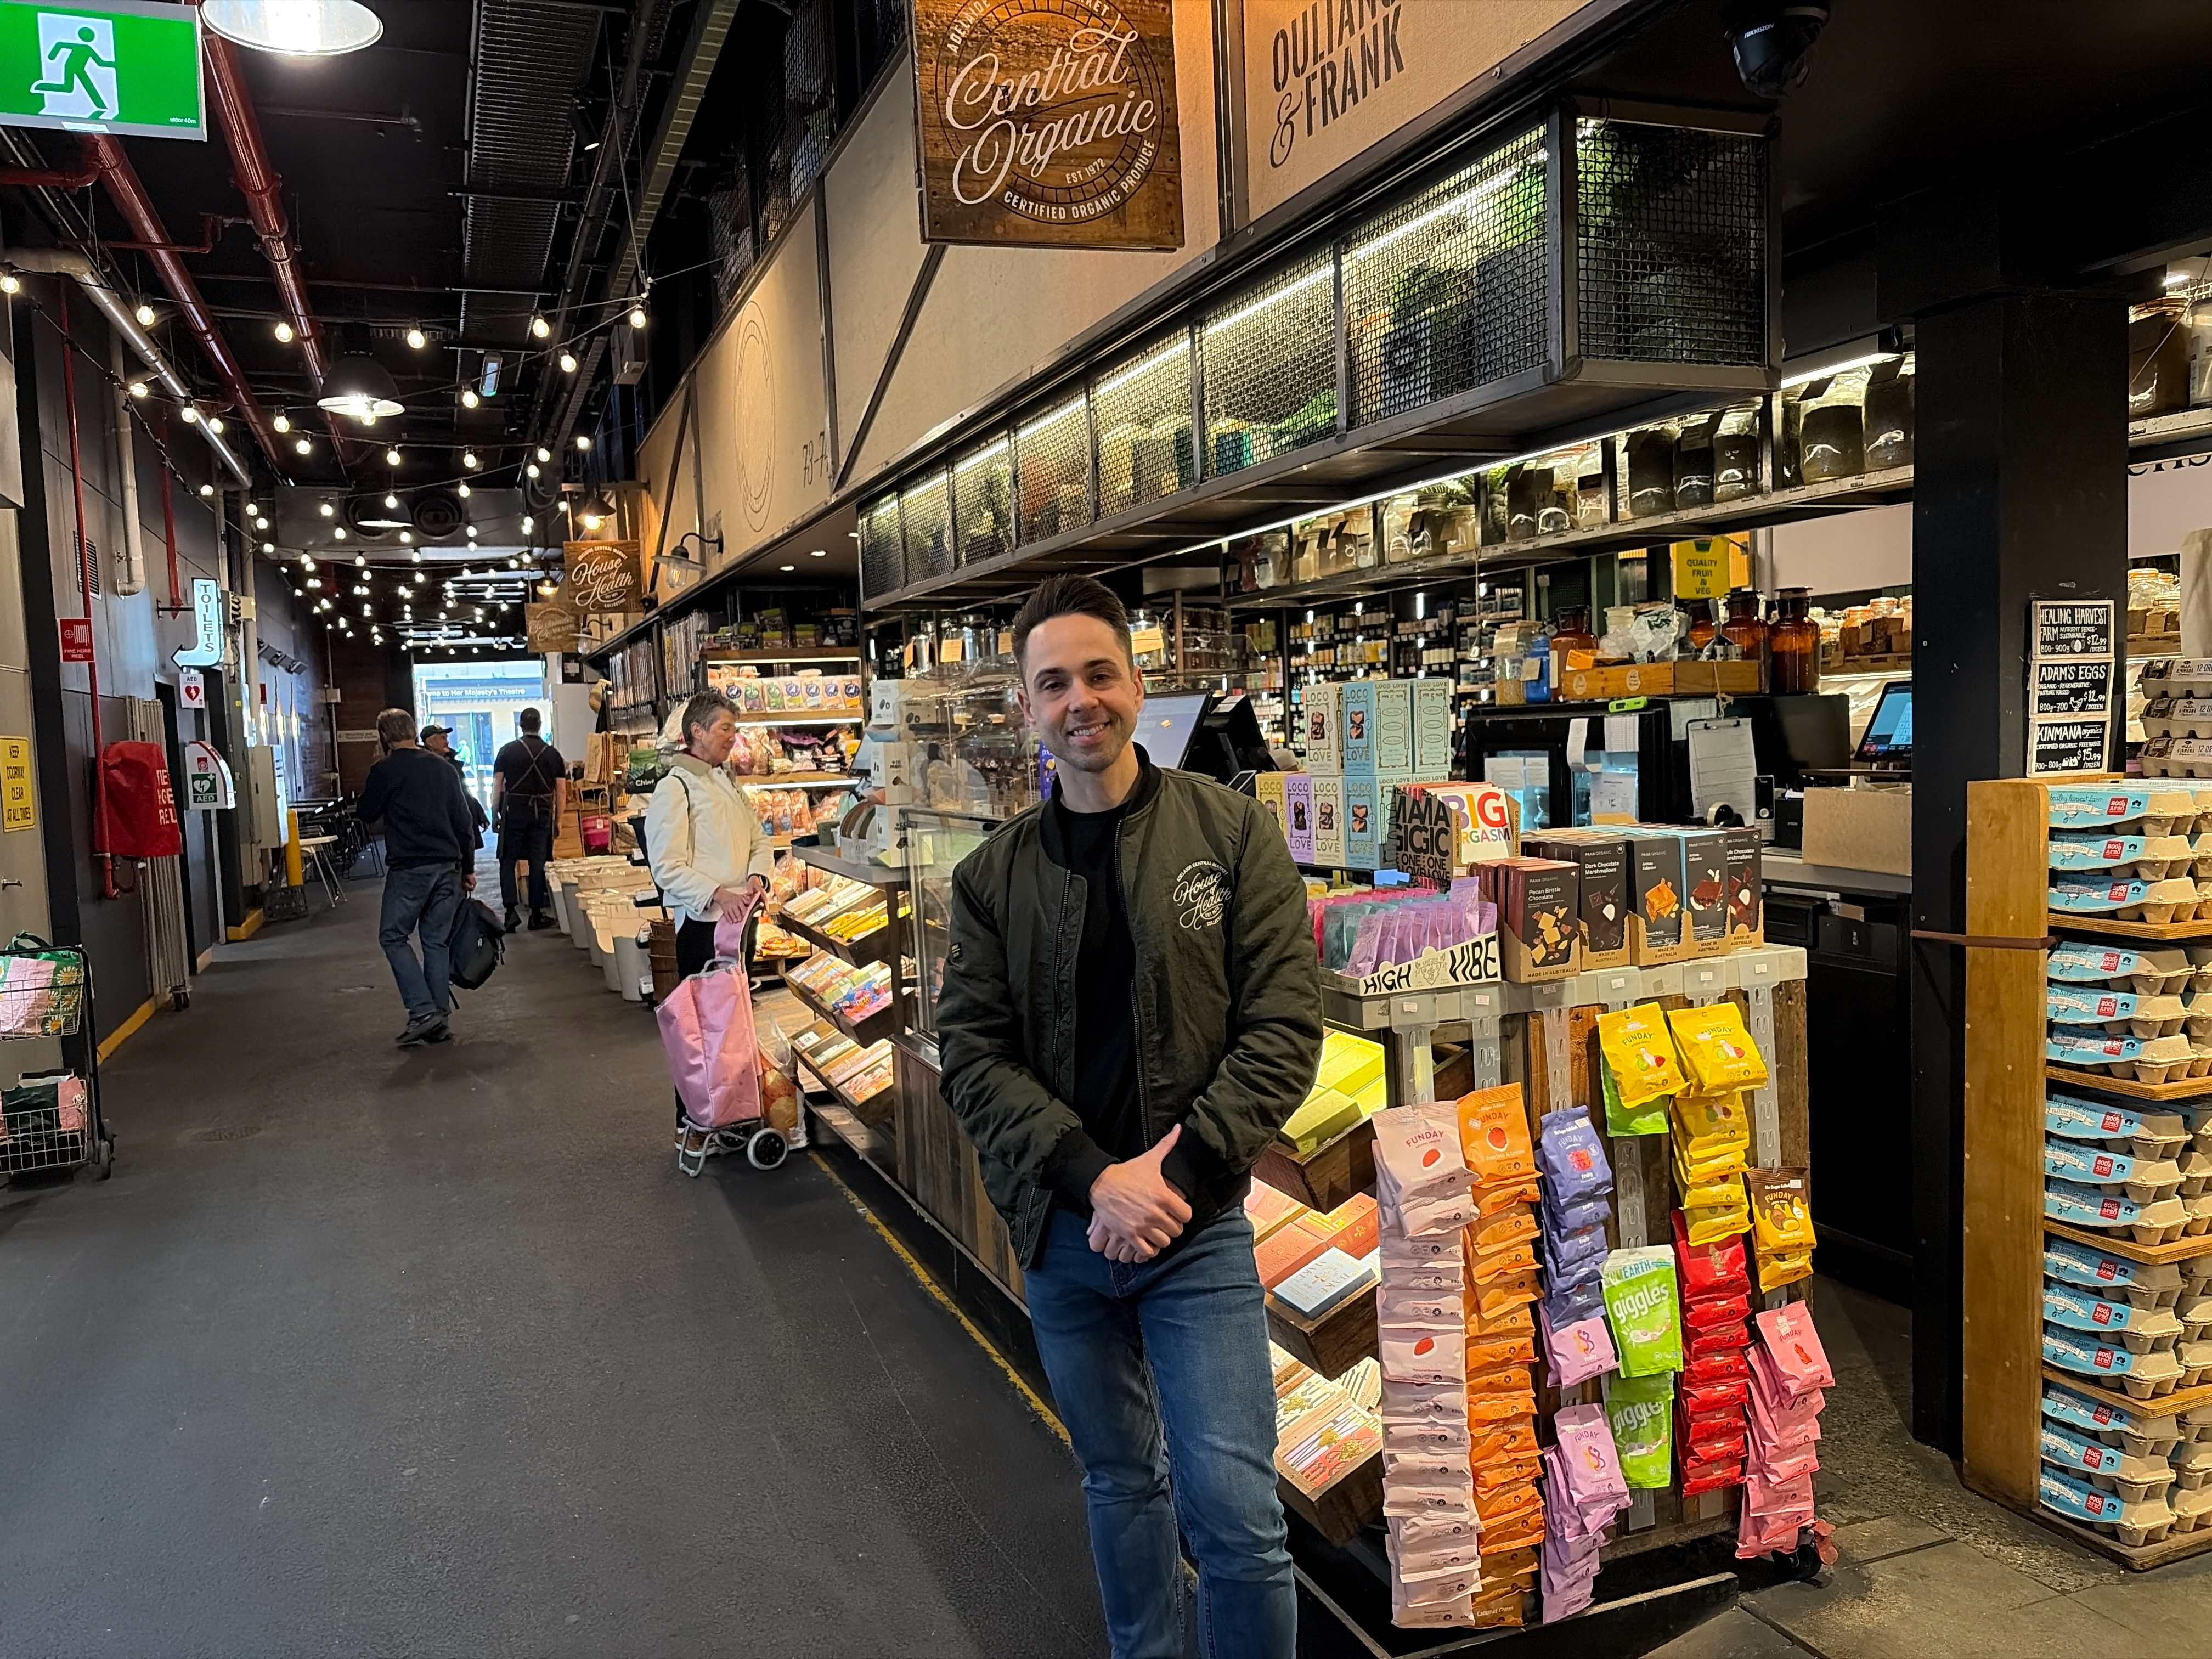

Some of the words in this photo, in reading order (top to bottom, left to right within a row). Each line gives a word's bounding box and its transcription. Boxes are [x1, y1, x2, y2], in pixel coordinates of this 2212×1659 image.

[946, 13, 1138, 130] Central
[1269, 89, 1303, 168] &
[1306, 3, 1404, 138] FRANK
[953, 91, 1156, 205] Organic
[1065, 173, 1084, 185] EST
[1084, 157, 1106, 181] 1972
[1003, 190, 1066, 219] CERTIFIED
[1071, 190, 1121, 219] ORGANIC
[1120, 139, 1155, 193] PRODUCE
[1686, 558, 1718, 567] QUALITY
[572, 556, 623, 585] House
[609, 567, 619, 580] of
[1692, 569, 1713, 578] FRUIT
[575, 572, 634, 611] Health
[1695, 586, 1711, 595] VEG
[200, 584, 215, 652] TOILETS
[2040, 608, 2072, 625] HEALING
[2074, 607, 2107, 625] HARVEST
[2040, 626, 2059, 642] FARM
[2040, 665, 2076, 682] ADAM'S
[2078, 665, 2107, 680] EGGS
[465, 689, 498, 697] Majesty's
[1306, 692, 1329, 703] LOCO
[1345, 688, 1368, 699] LOCO
[2036, 725, 2082, 742] KINMANA
[2081, 726, 2103, 737] organics
[1308, 751, 1332, 762] LOVE
[1346, 750, 1370, 761] LOVE
[1259, 781, 1282, 792] LOCO
[1287, 782, 1309, 792] LOCO
[1314, 782, 1338, 792] LOCO
[2050, 794, 2067, 804] healing
[2068, 794, 2088, 803] harvest
[2088, 794, 2103, 805] farm
[1462, 827, 1510, 844] RGASM
[1290, 839, 1312, 850] LOVE
[1316, 842, 1340, 853] LOVE
[1401, 854, 1421, 867] ONE
[1427, 856, 1447, 870] ONE
[1173, 872, 1222, 906] House
[1210, 882, 1220, 896] of
[1180, 887, 1232, 930] Health
[1364, 964, 1412, 994] HIGH
[1449, 935, 1498, 983] VIBE
[1622, 1032, 1654, 1046] FUNDAY
[1406, 1130, 1444, 1147] FUNDAY
[1558, 1135, 1583, 1148] FUNDAY
[1764, 1191, 1792, 1203] FUNDAY
[1613, 1283, 1669, 1324] giggles
[1575, 1430, 1598, 1442] FUNDAY
[2089, 1495, 2102, 1505] 800g
